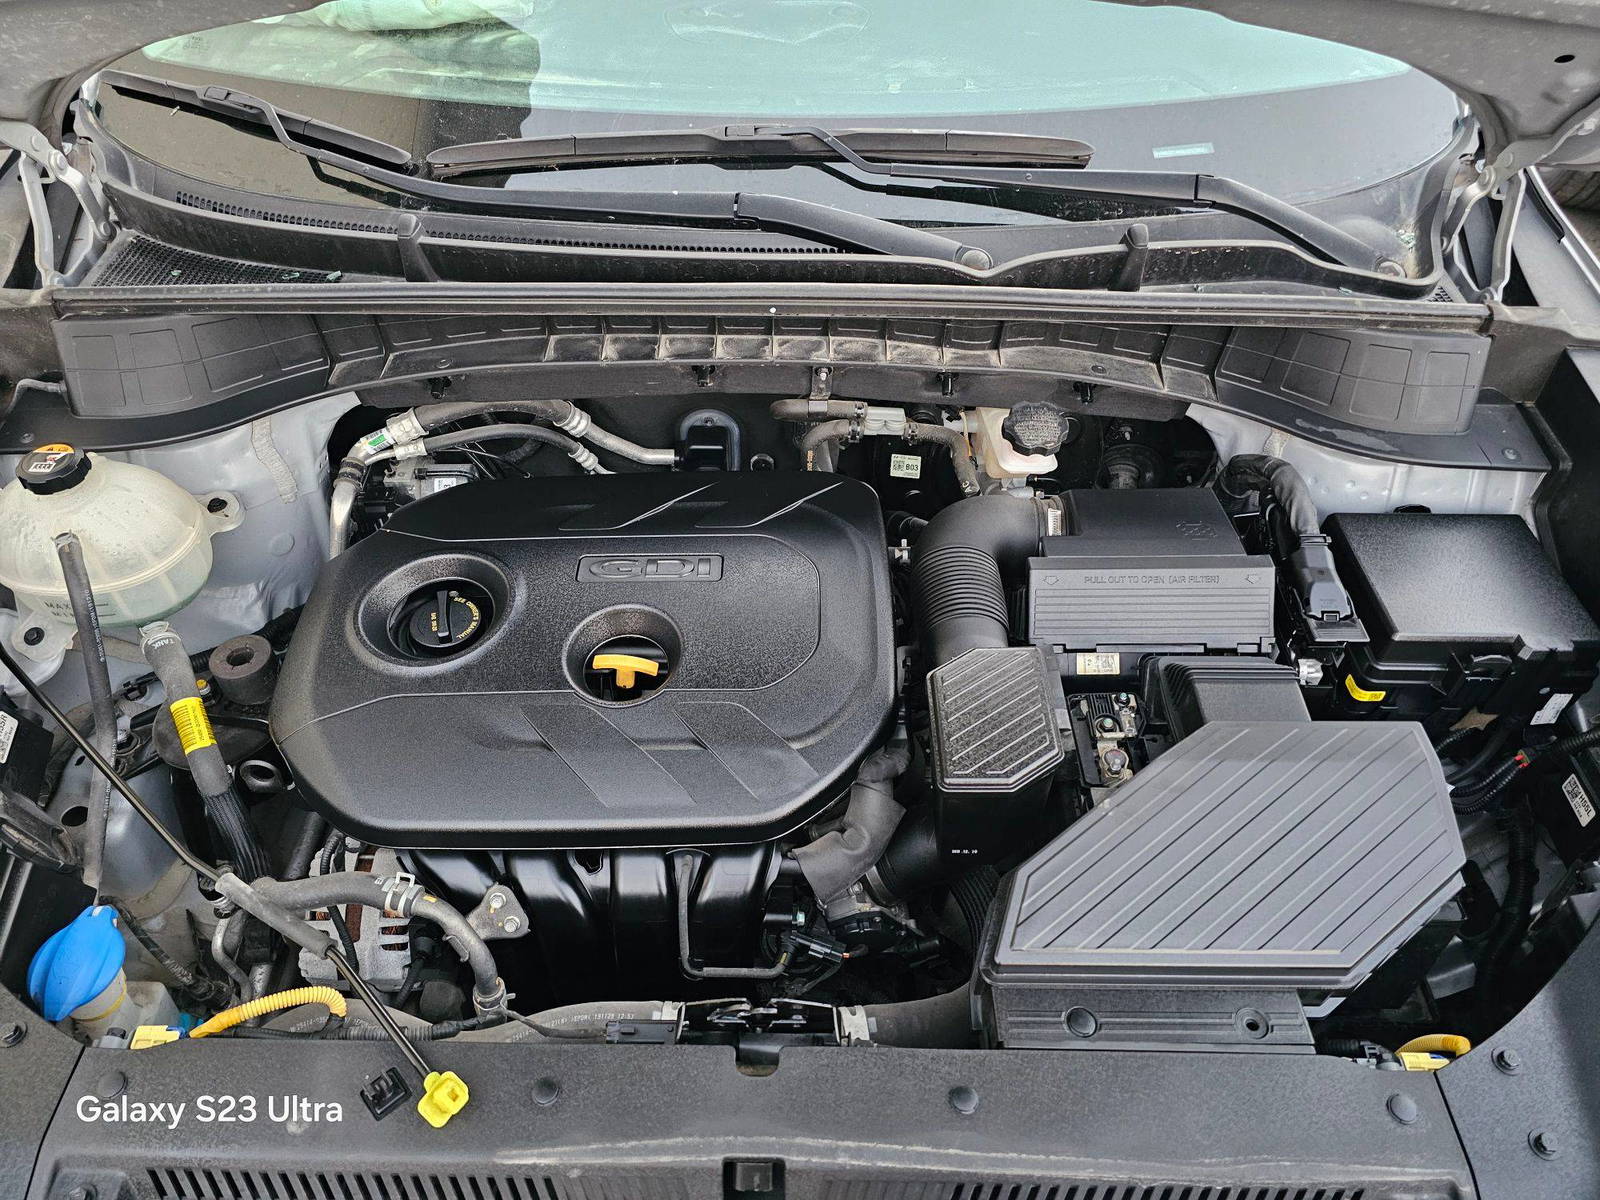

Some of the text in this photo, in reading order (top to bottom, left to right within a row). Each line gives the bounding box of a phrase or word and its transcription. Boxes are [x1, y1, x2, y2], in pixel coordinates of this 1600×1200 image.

[589, 558, 711, 578] GDI
[1084, 576, 1106, 584] PULL
[1141, 576, 1165, 584] OPEN
